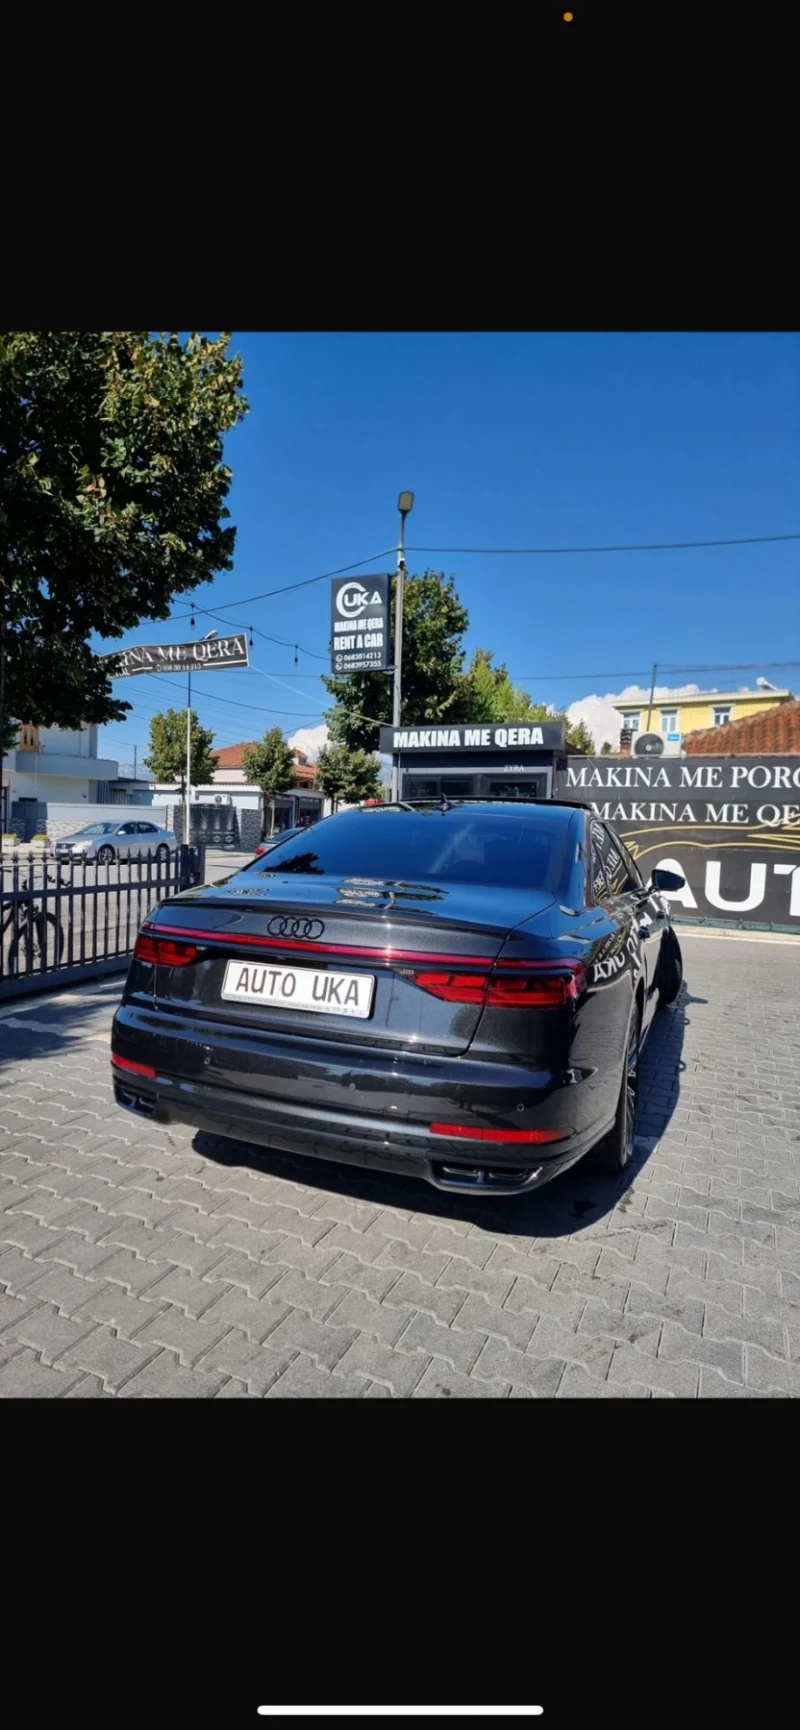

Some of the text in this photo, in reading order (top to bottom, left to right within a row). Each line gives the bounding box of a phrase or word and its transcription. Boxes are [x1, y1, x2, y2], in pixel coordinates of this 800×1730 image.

[334, 617, 383, 633] MAKINA ME QERA
[157, 646, 186, 661] ME
[192, 637, 245, 662] QERA
[334, 633, 383, 651] RENT A CAR
[393, 727, 544, 748] MAKINA ME QERA
[503, 764, 525, 772] ZYRA
[565, 766, 800, 788] MAKINA ME POR
[590, 801, 697, 822] MAKINA
[705, 804, 749, 823] ME
[235, 967, 296, 997] AUTO
[312, 975, 359, 1006] UKA
